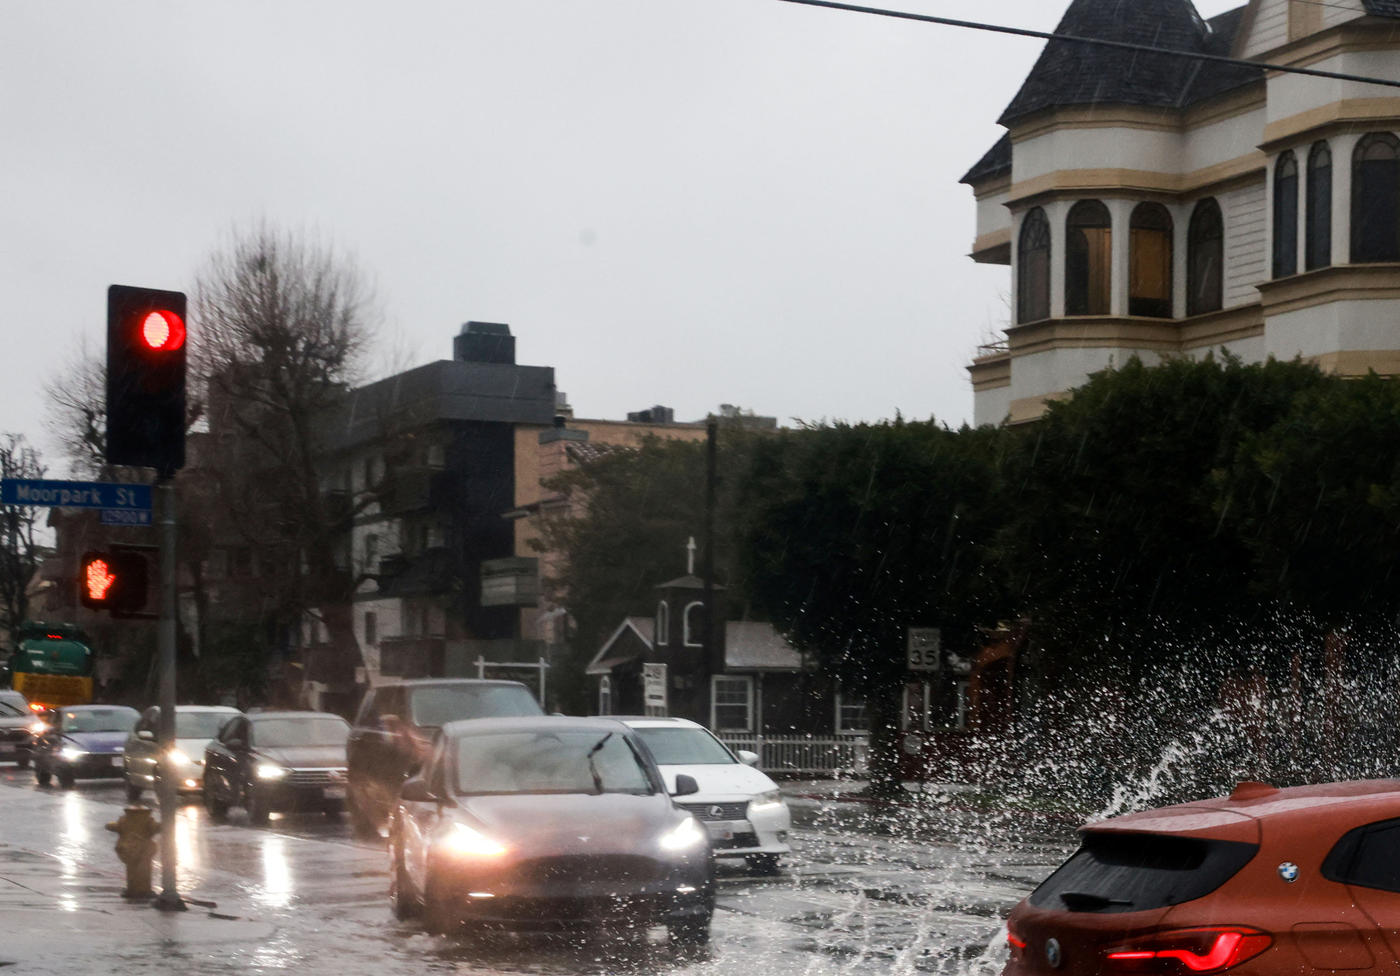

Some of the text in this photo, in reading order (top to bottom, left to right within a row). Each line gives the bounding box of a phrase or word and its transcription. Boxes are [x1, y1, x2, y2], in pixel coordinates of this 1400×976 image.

[16, 483, 137, 507] Moorpark St
[911, 649, 937, 666] 35
